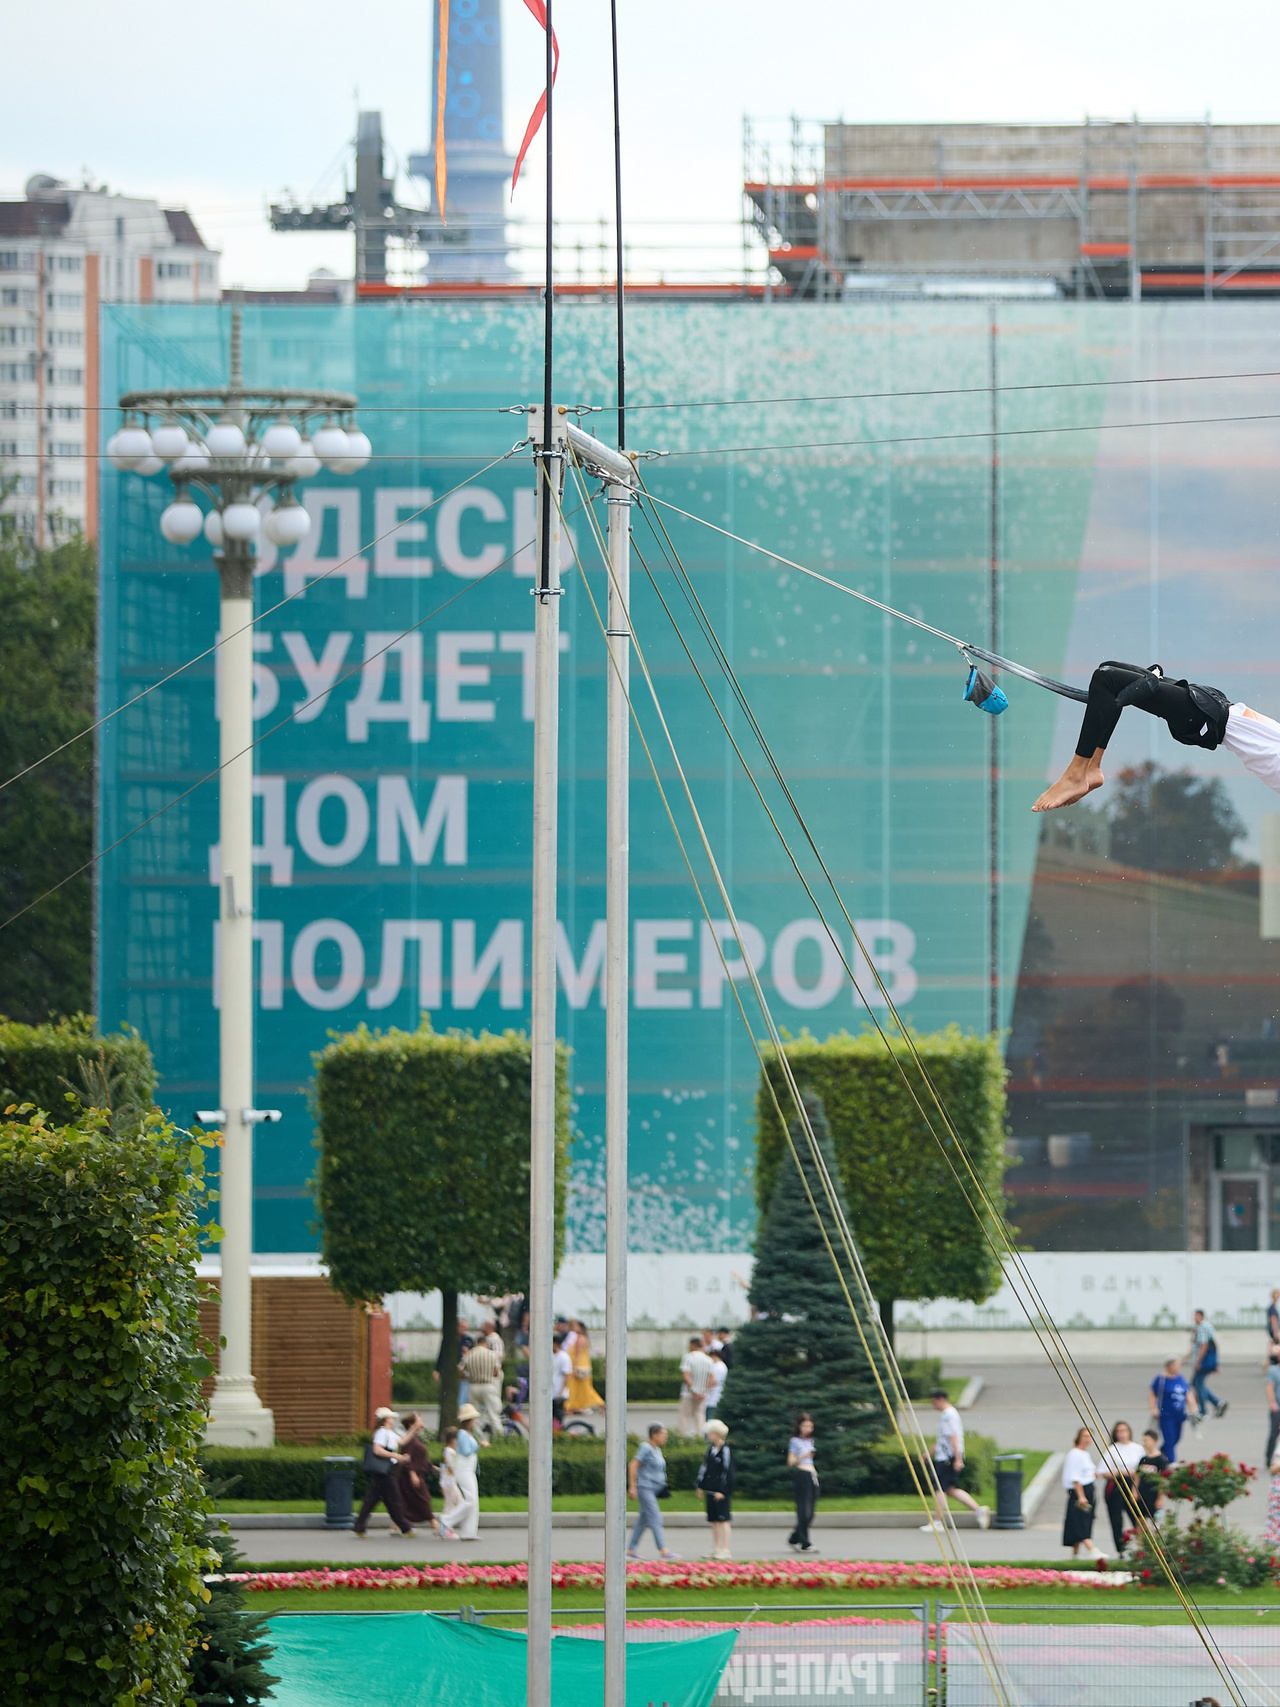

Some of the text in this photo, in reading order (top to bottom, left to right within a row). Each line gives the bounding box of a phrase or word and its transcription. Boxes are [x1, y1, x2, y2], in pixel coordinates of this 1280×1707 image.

[214, 631, 570, 743] БУДЕТ
[208, 773, 468, 887] ДОМ
[212, 917, 919, 1010] ПОЛИМЕРОВ
[1081, 1274, 1163, 1292] ВДНХ
